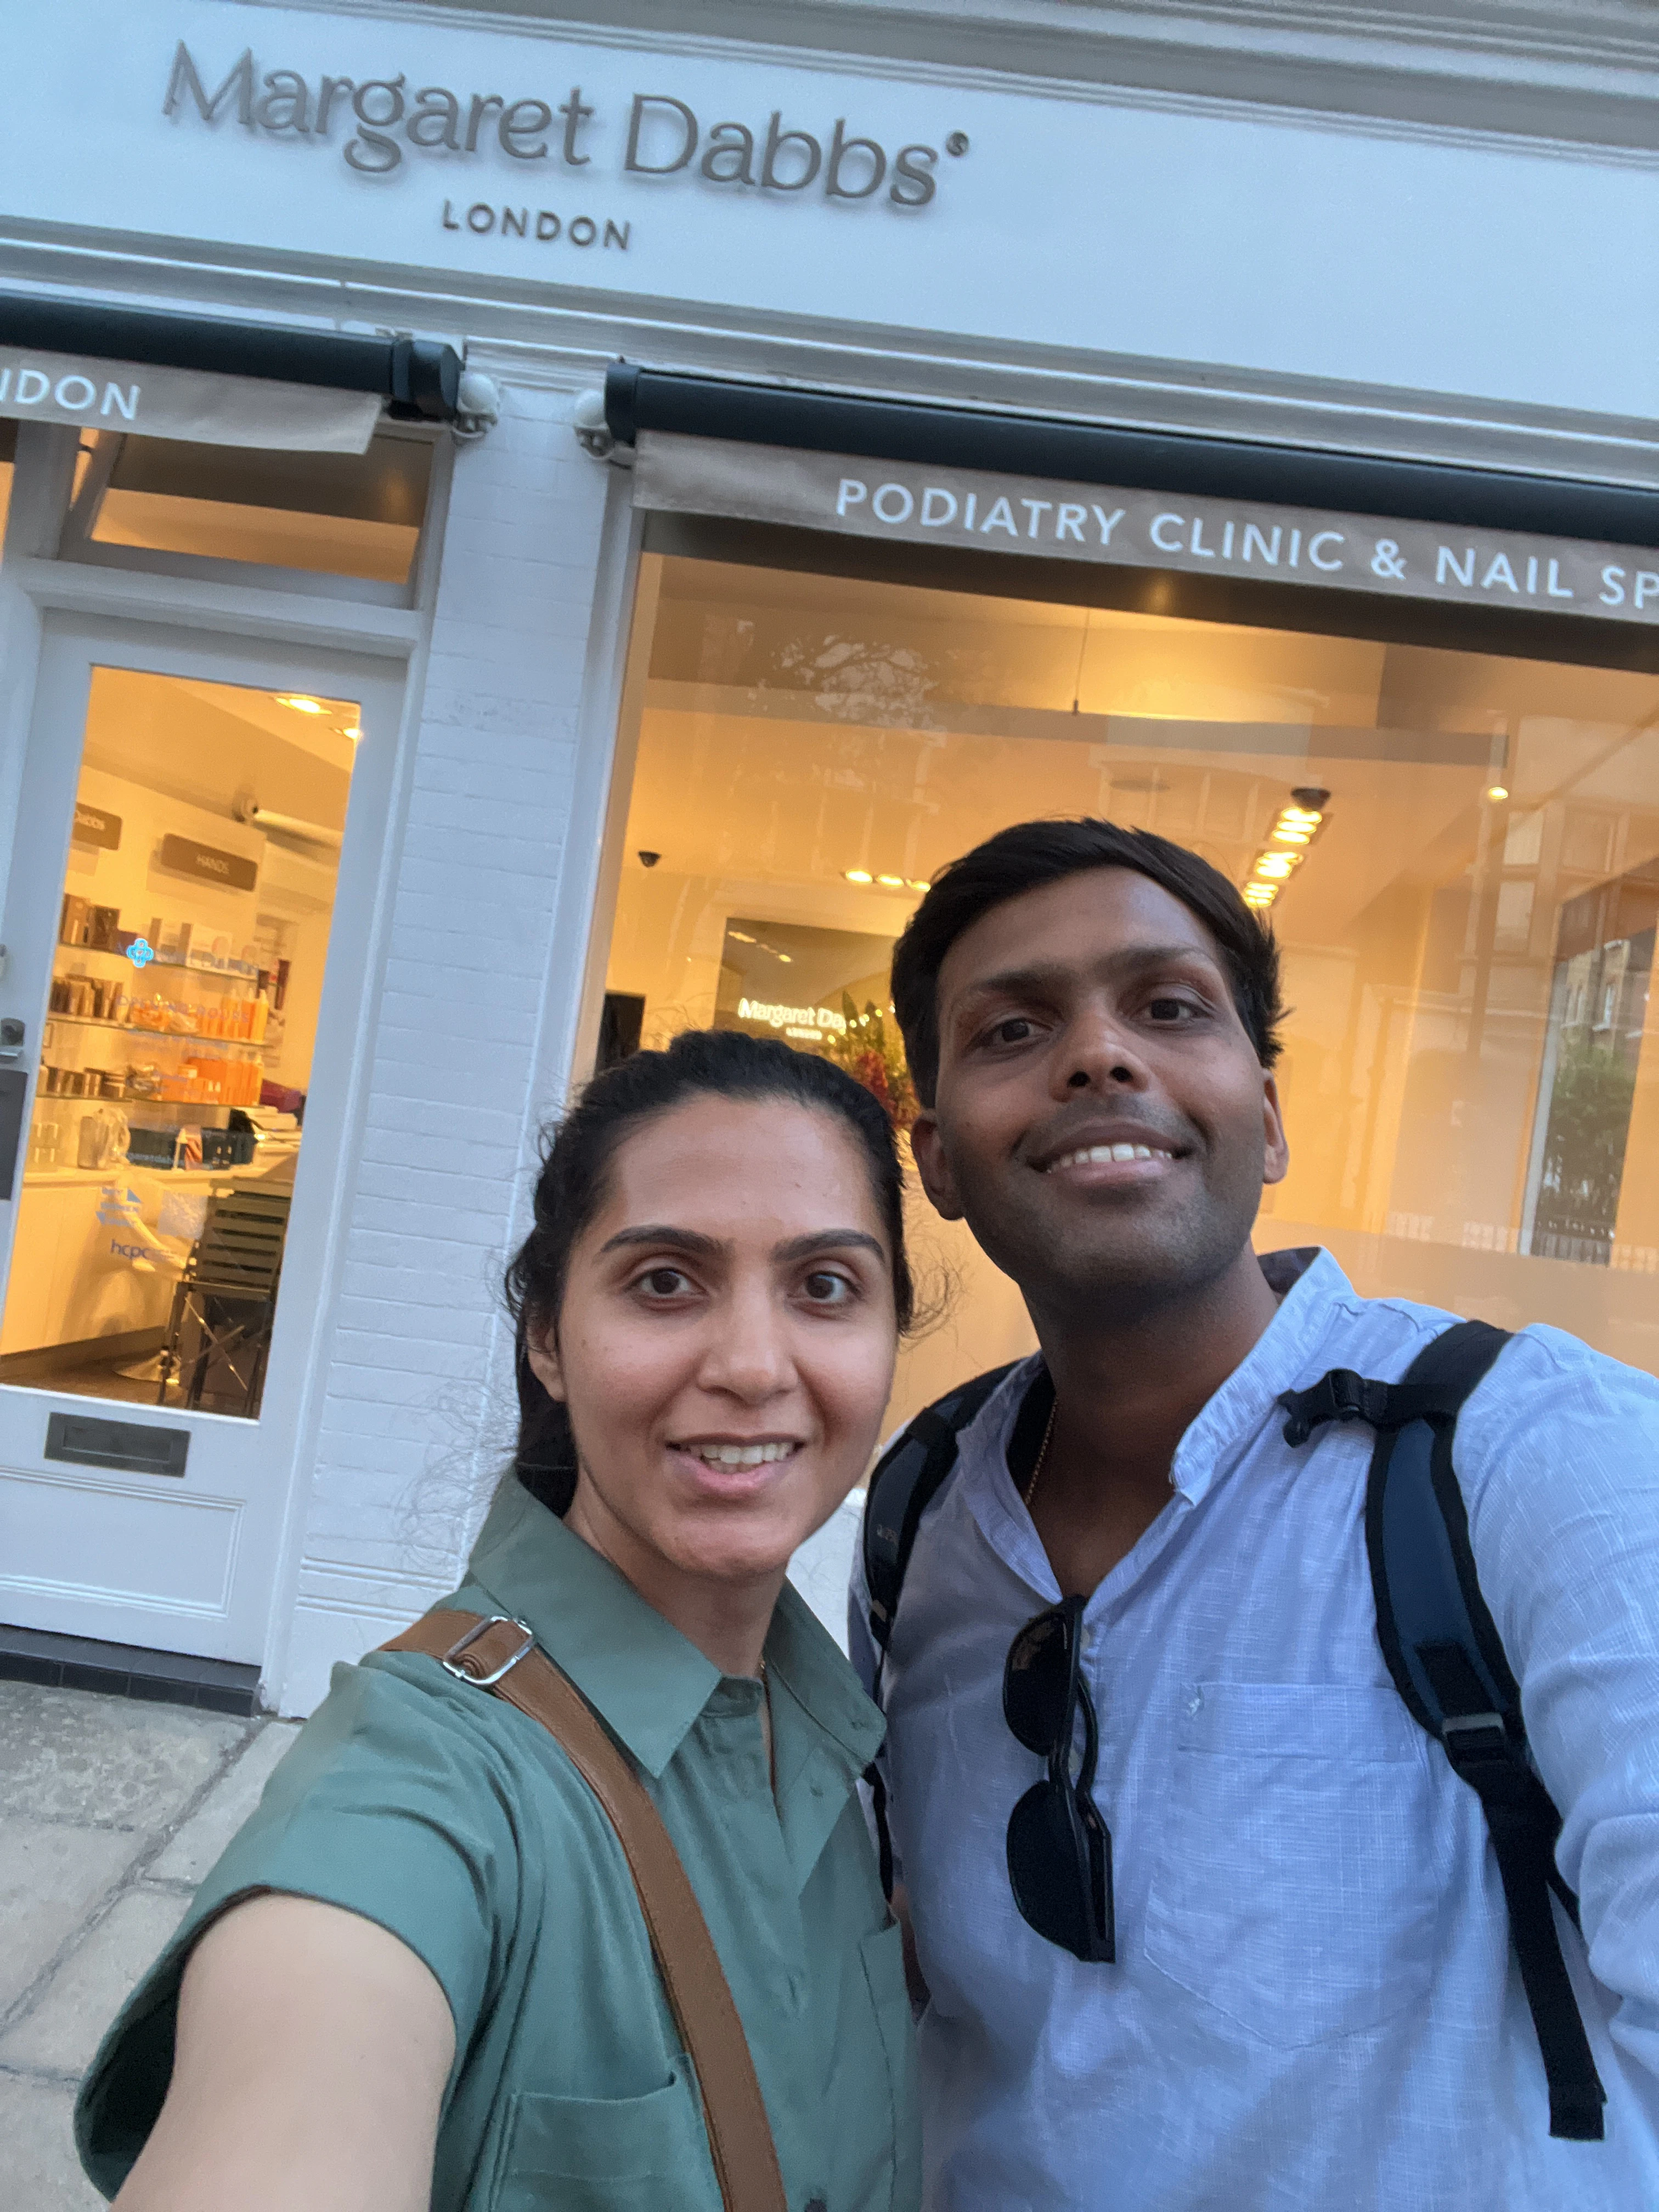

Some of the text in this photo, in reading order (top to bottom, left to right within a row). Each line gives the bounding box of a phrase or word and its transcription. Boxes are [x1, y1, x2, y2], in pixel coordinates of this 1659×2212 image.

[163, 39, 594, 172] Margaret
[442, 199, 631, 250] LONDON
[0, 368, 141, 420] DON
[836, 478, 1659, 610] PODIATRY CLINIC & NAIL SP
[738, 997, 846, 1030] Margaret Da
